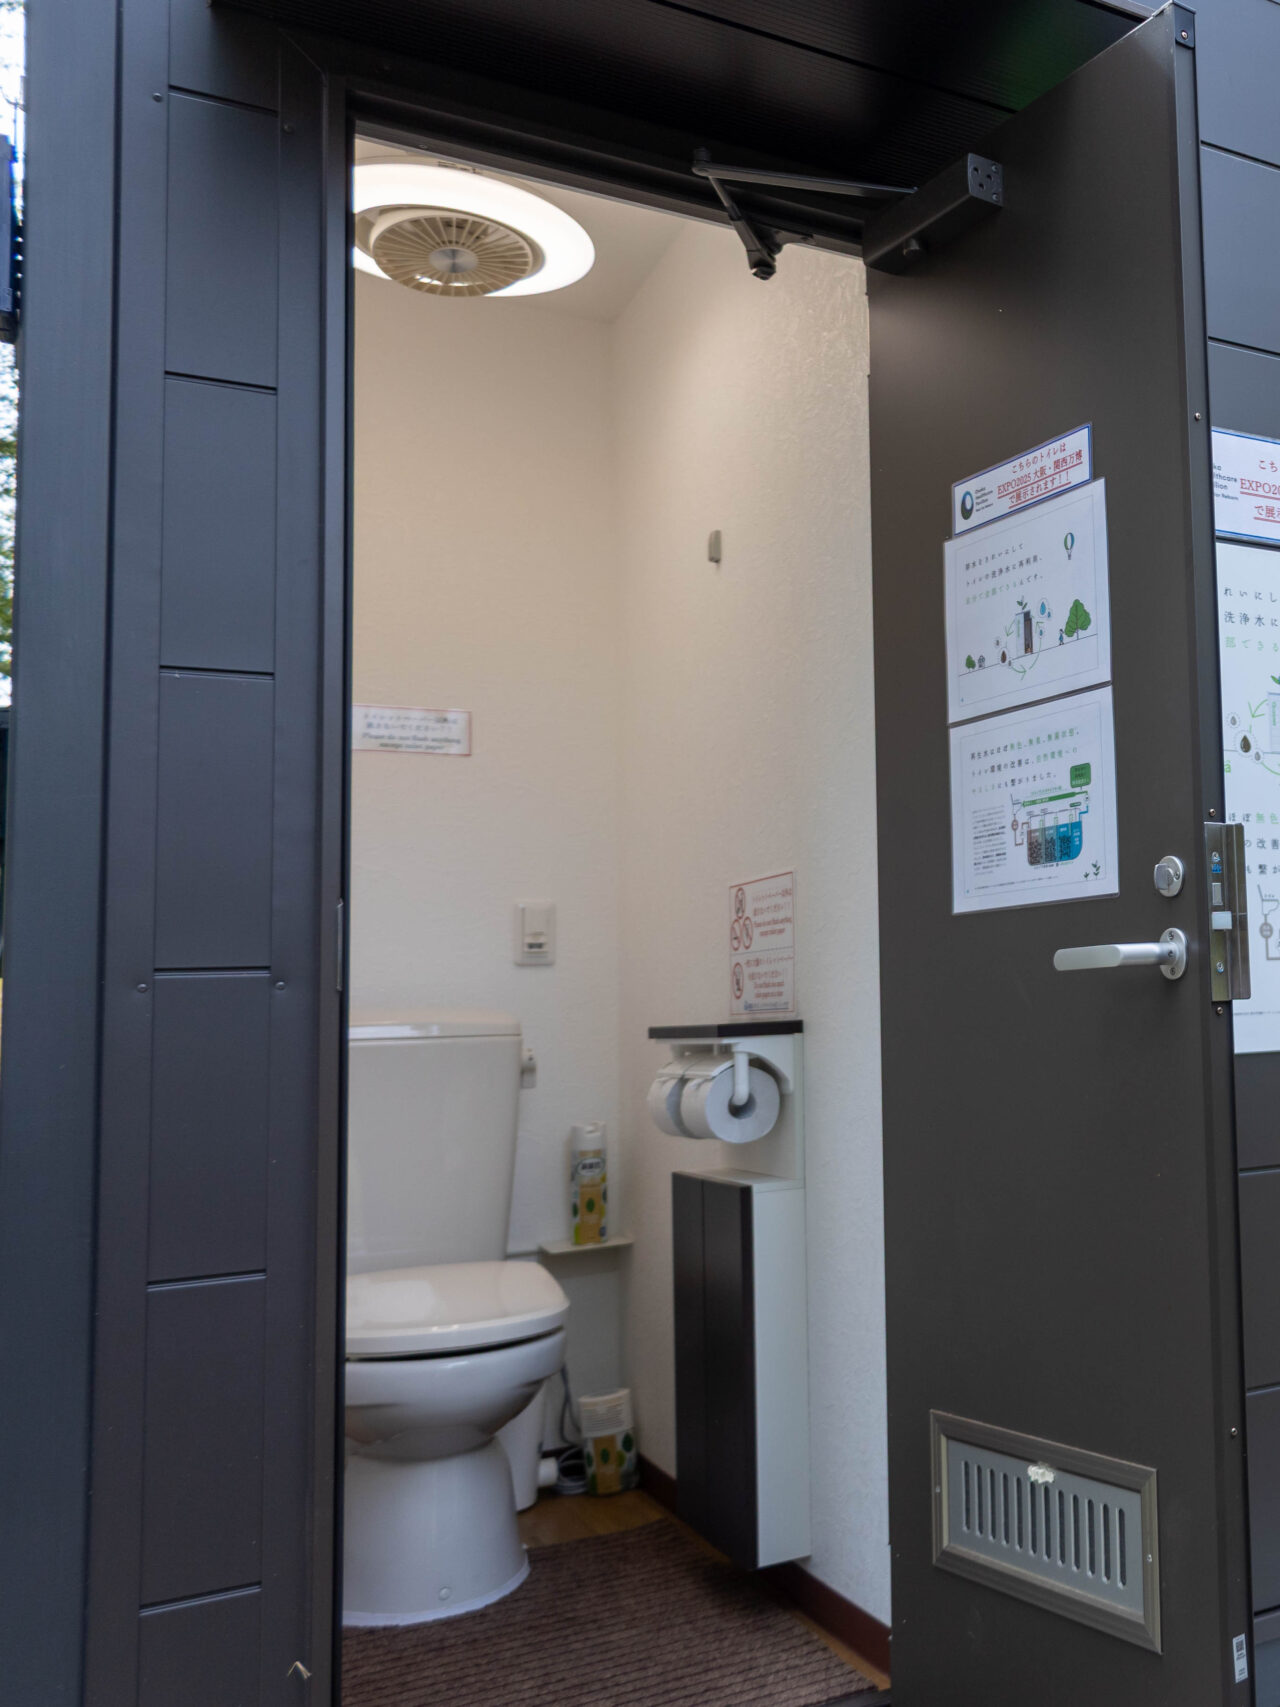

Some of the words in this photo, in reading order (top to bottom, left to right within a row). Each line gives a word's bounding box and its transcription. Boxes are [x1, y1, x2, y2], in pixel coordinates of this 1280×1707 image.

[998, 472, 1032, 495] EXPO2025
[1033, 449, 1083, 480] 大阪・関西万博
[1012, 442, 1066, 473] こちらのトイレは
